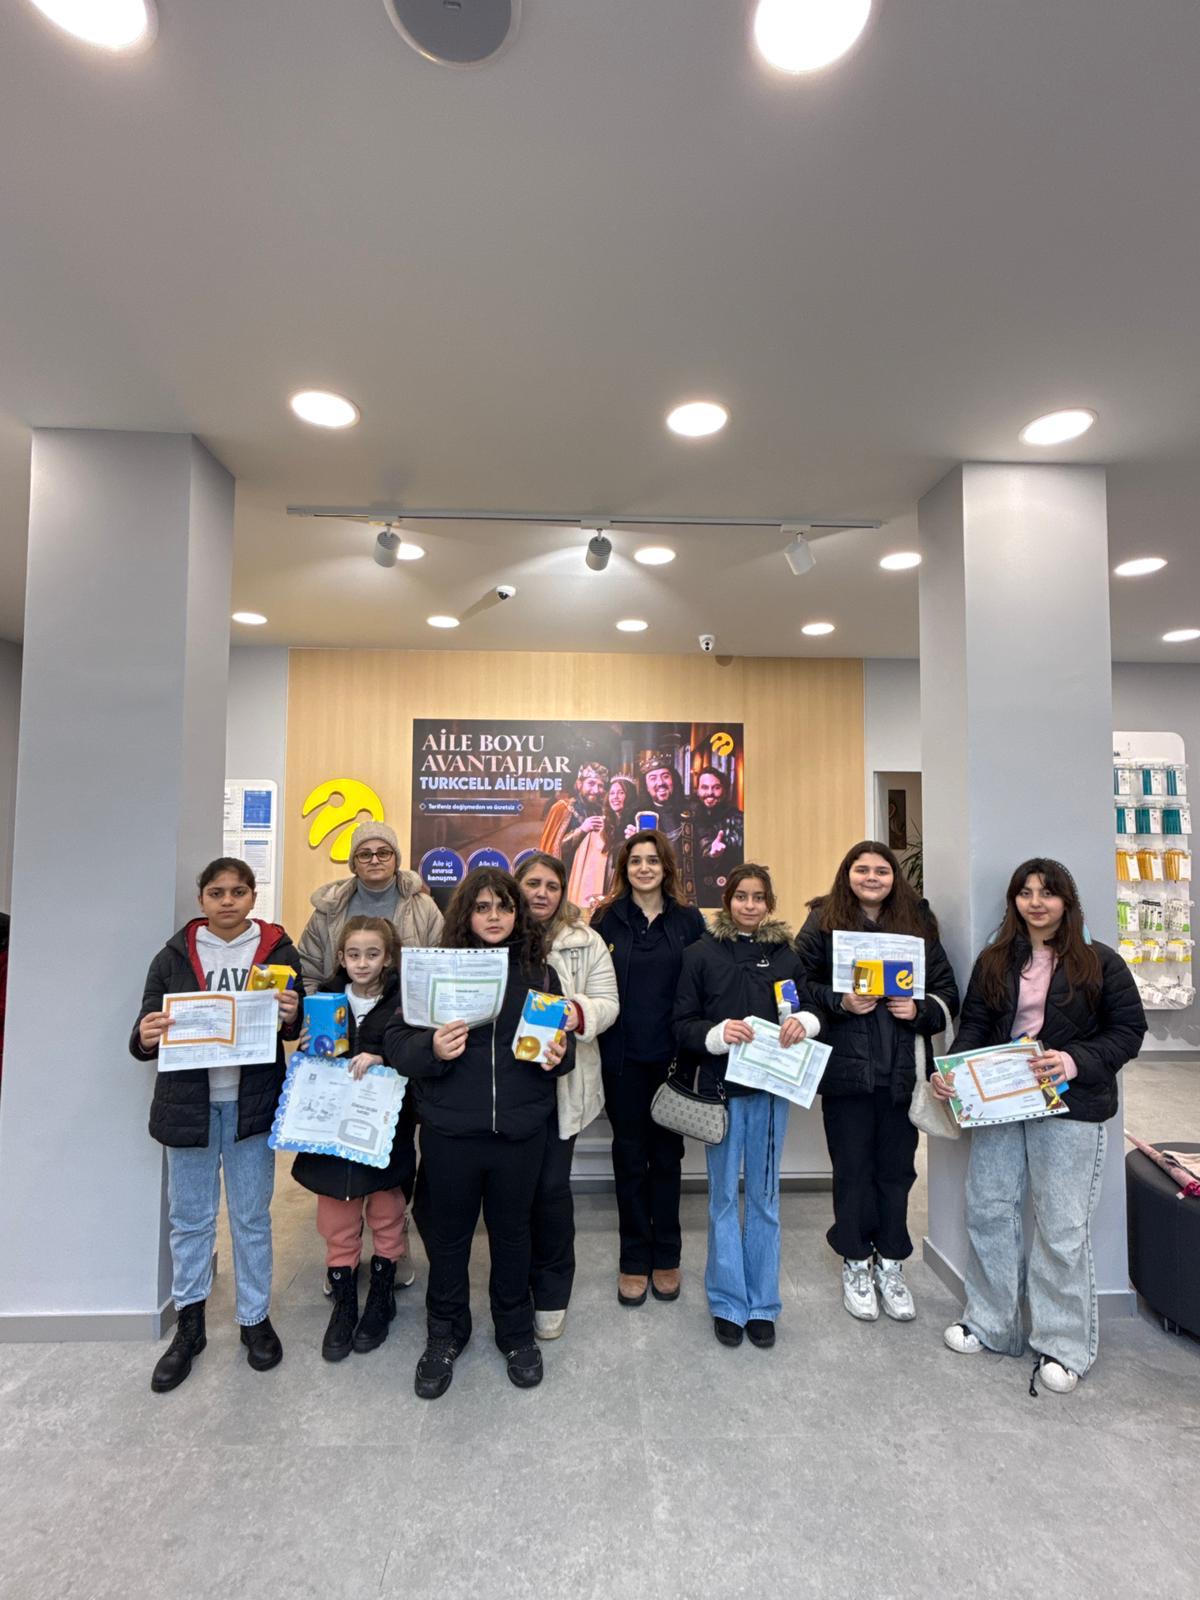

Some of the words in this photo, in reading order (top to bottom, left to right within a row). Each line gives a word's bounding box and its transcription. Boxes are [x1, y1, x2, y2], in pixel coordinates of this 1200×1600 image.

[422, 729, 473, 751] AİLE
[480, 734, 545, 752] BOYU
[420, 754, 572, 777] AVANTAJLAR
[420, 776, 492, 790] TURKCELL
[445, 860, 453, 868] içi
[427, 874, 457, 882] konuşma
